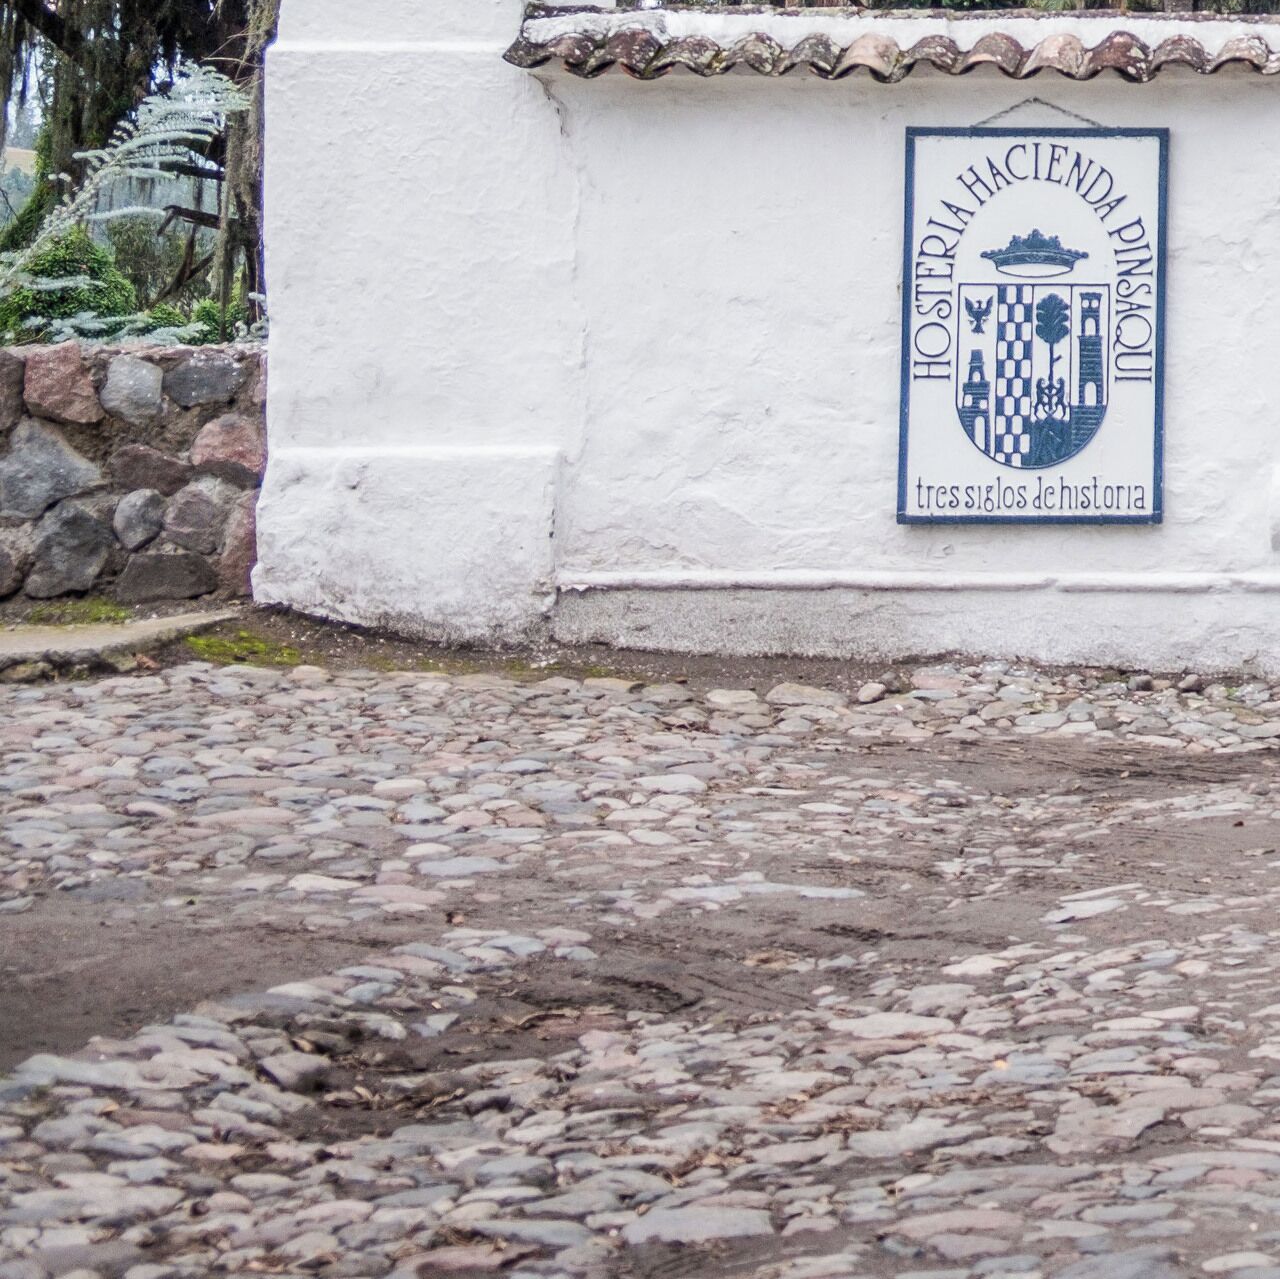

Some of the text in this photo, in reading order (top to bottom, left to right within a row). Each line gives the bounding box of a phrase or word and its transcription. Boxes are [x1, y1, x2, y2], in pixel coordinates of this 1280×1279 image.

[913, 142, 1154, 383] HOSTERIA HACIENDA PINSAQUI
[916, 476, 1146, 512] tres siglos de historia
